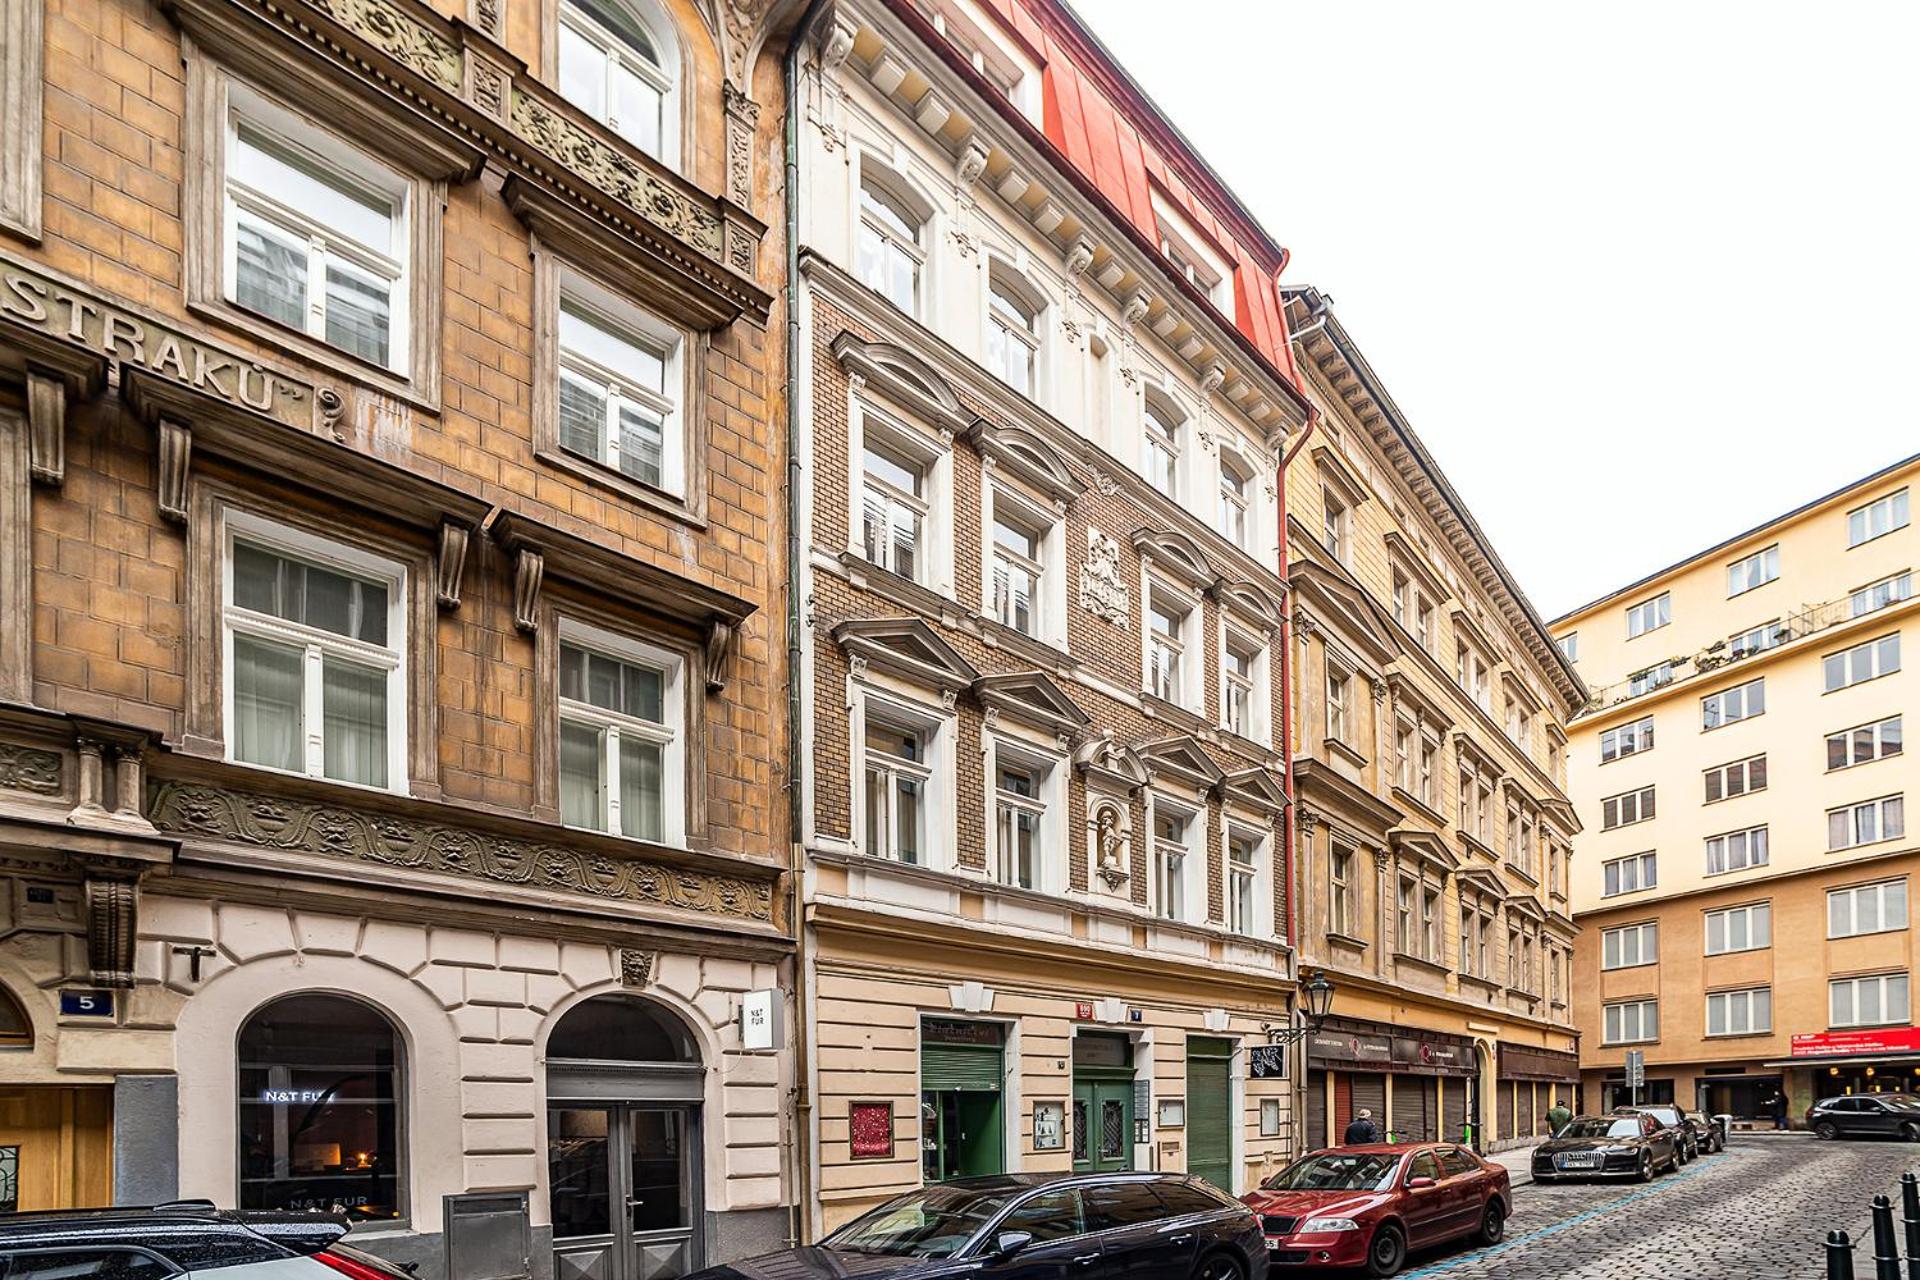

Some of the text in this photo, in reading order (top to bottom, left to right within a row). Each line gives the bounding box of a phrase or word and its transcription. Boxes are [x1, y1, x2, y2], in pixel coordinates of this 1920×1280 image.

[79, 995, 95, 1010] 5
[265, 1089, 336, 1104] N&T FU
[291, 1196, 368, 1209] N&T FUR
